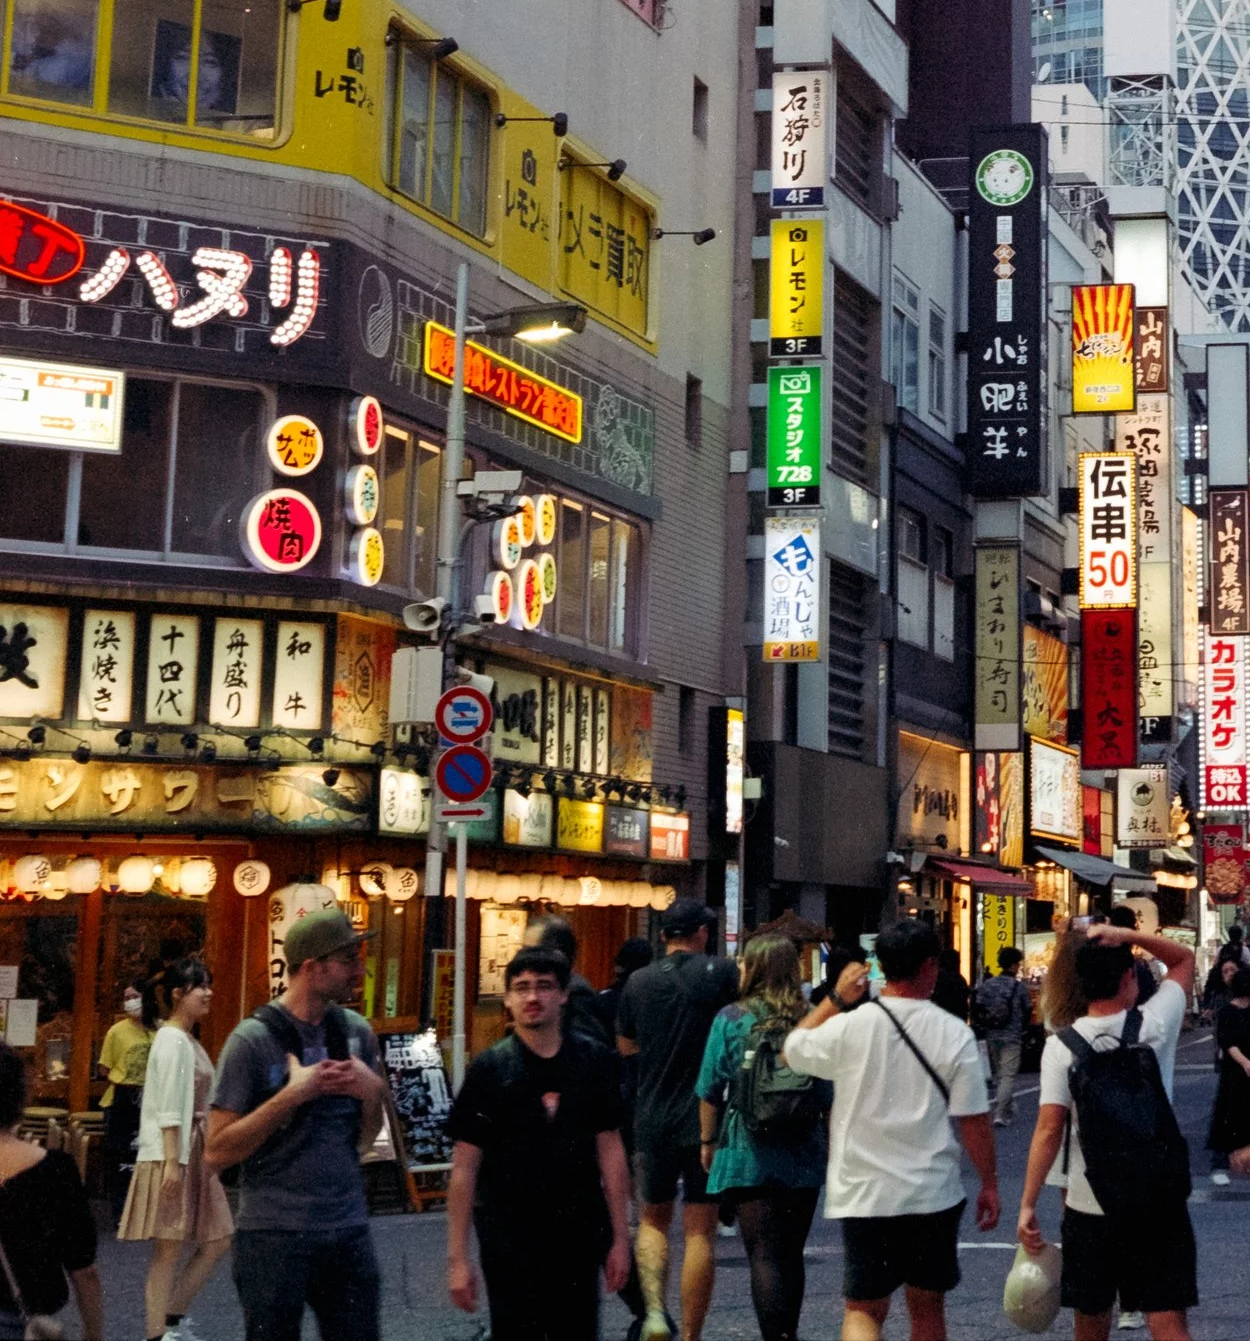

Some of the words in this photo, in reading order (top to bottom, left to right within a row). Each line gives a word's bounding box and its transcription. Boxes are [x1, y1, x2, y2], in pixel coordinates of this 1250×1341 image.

[781, 86, 809, 181] 石狩川
[785, 189, 810, 204] 4F
[80, 247, 320, 347] ハヌリ
[788, 248, 807, 333] レモン社
[785, 340, 808, 354] 3F
[786, 396, 804, 464] スタジオ
[980, 336, 1017, 460] 小肥羊
[777, 465, 813, 483] 728
[783, 489, 806, 504] 3F
[1090, 459, 1127, 545] 伝串
[264, 498, 303, 562] 焼肉
[1089, 550, 1128, 588] 50
[1217, 518, 1245, 613] 山内農場
[93, 620, 121, 713] 浜焼き
[1221, 617, 1240, 631] 4F
[155, 626, 184, 717] 十四代
[222, 628, 250, 719] 舟盛り
[284, 631, 312, 717] 和牛
[1211, 639, 1237, 748] カラオケ
[1210, 768, 1242, 785] 持込
[1210, 785, 1242, 803] OK
